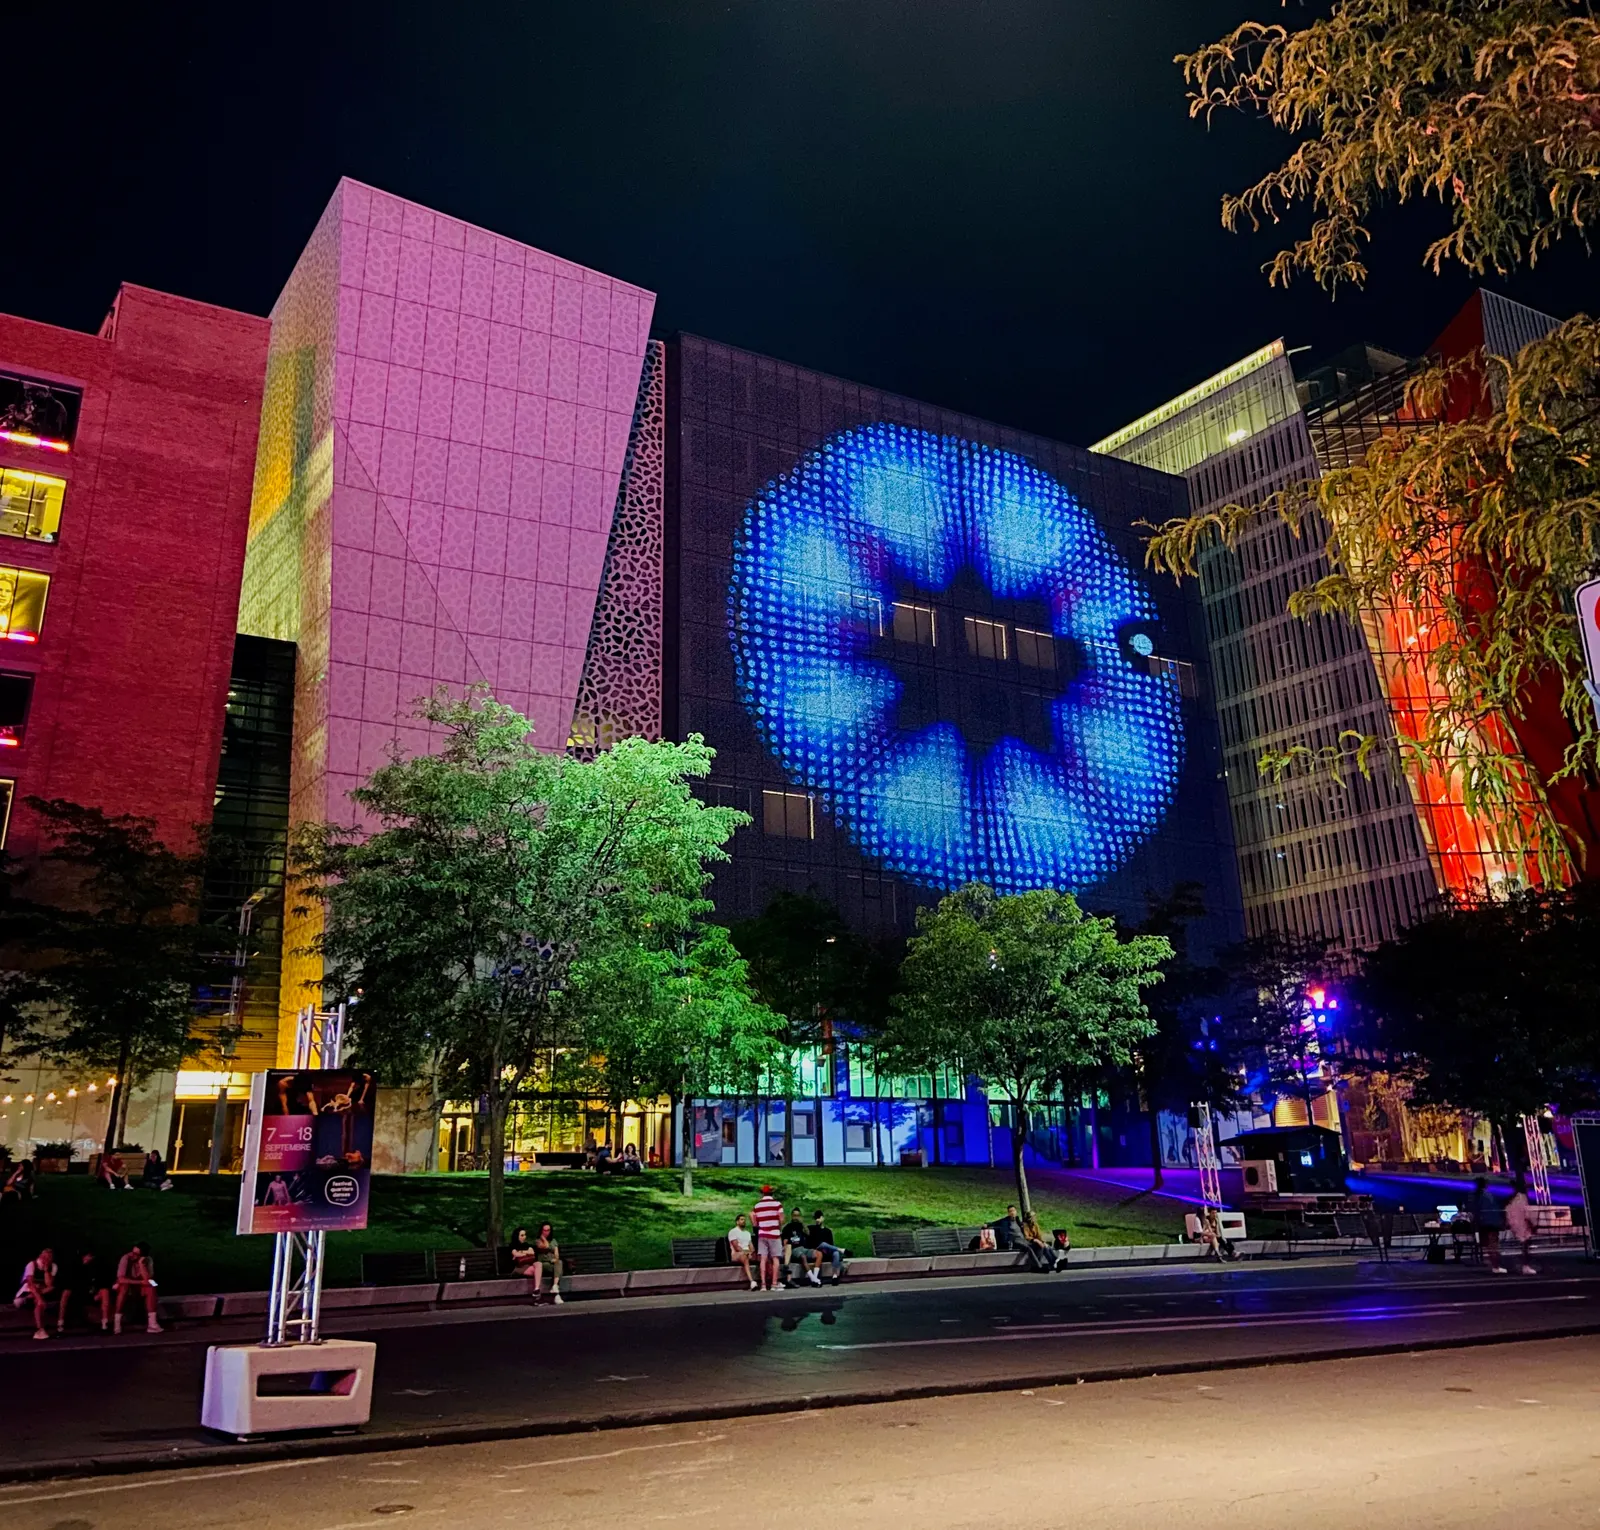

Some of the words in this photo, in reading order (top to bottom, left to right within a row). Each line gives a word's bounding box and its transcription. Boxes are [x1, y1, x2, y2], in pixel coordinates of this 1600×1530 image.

[266, 1127, 277, 1142] 7
[296, 1126, 312, 1141] 18
[264, 1143, 311, 1152] SEPTEMBRE
[264, 1152, 283, 1160] 2022
